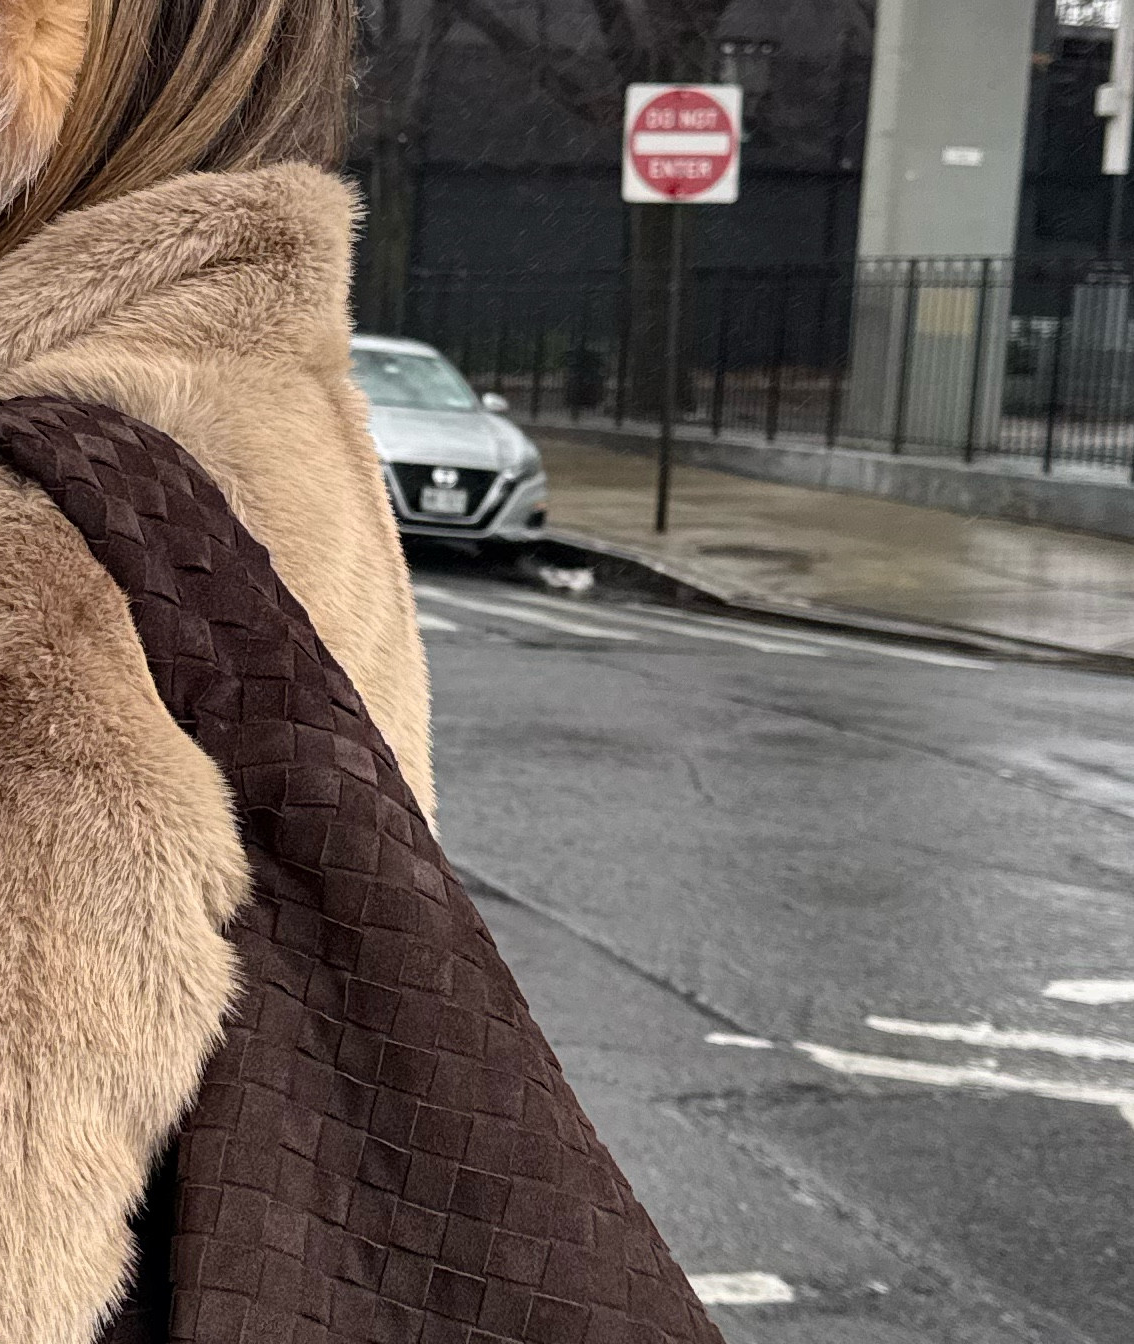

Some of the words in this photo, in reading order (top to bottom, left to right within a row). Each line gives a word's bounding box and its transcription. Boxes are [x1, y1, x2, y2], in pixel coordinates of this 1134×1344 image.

[647, 108, 676, 129] DO
[679, 108, 718, 129] NOT
[649, 158, 712, 179] ENTER
